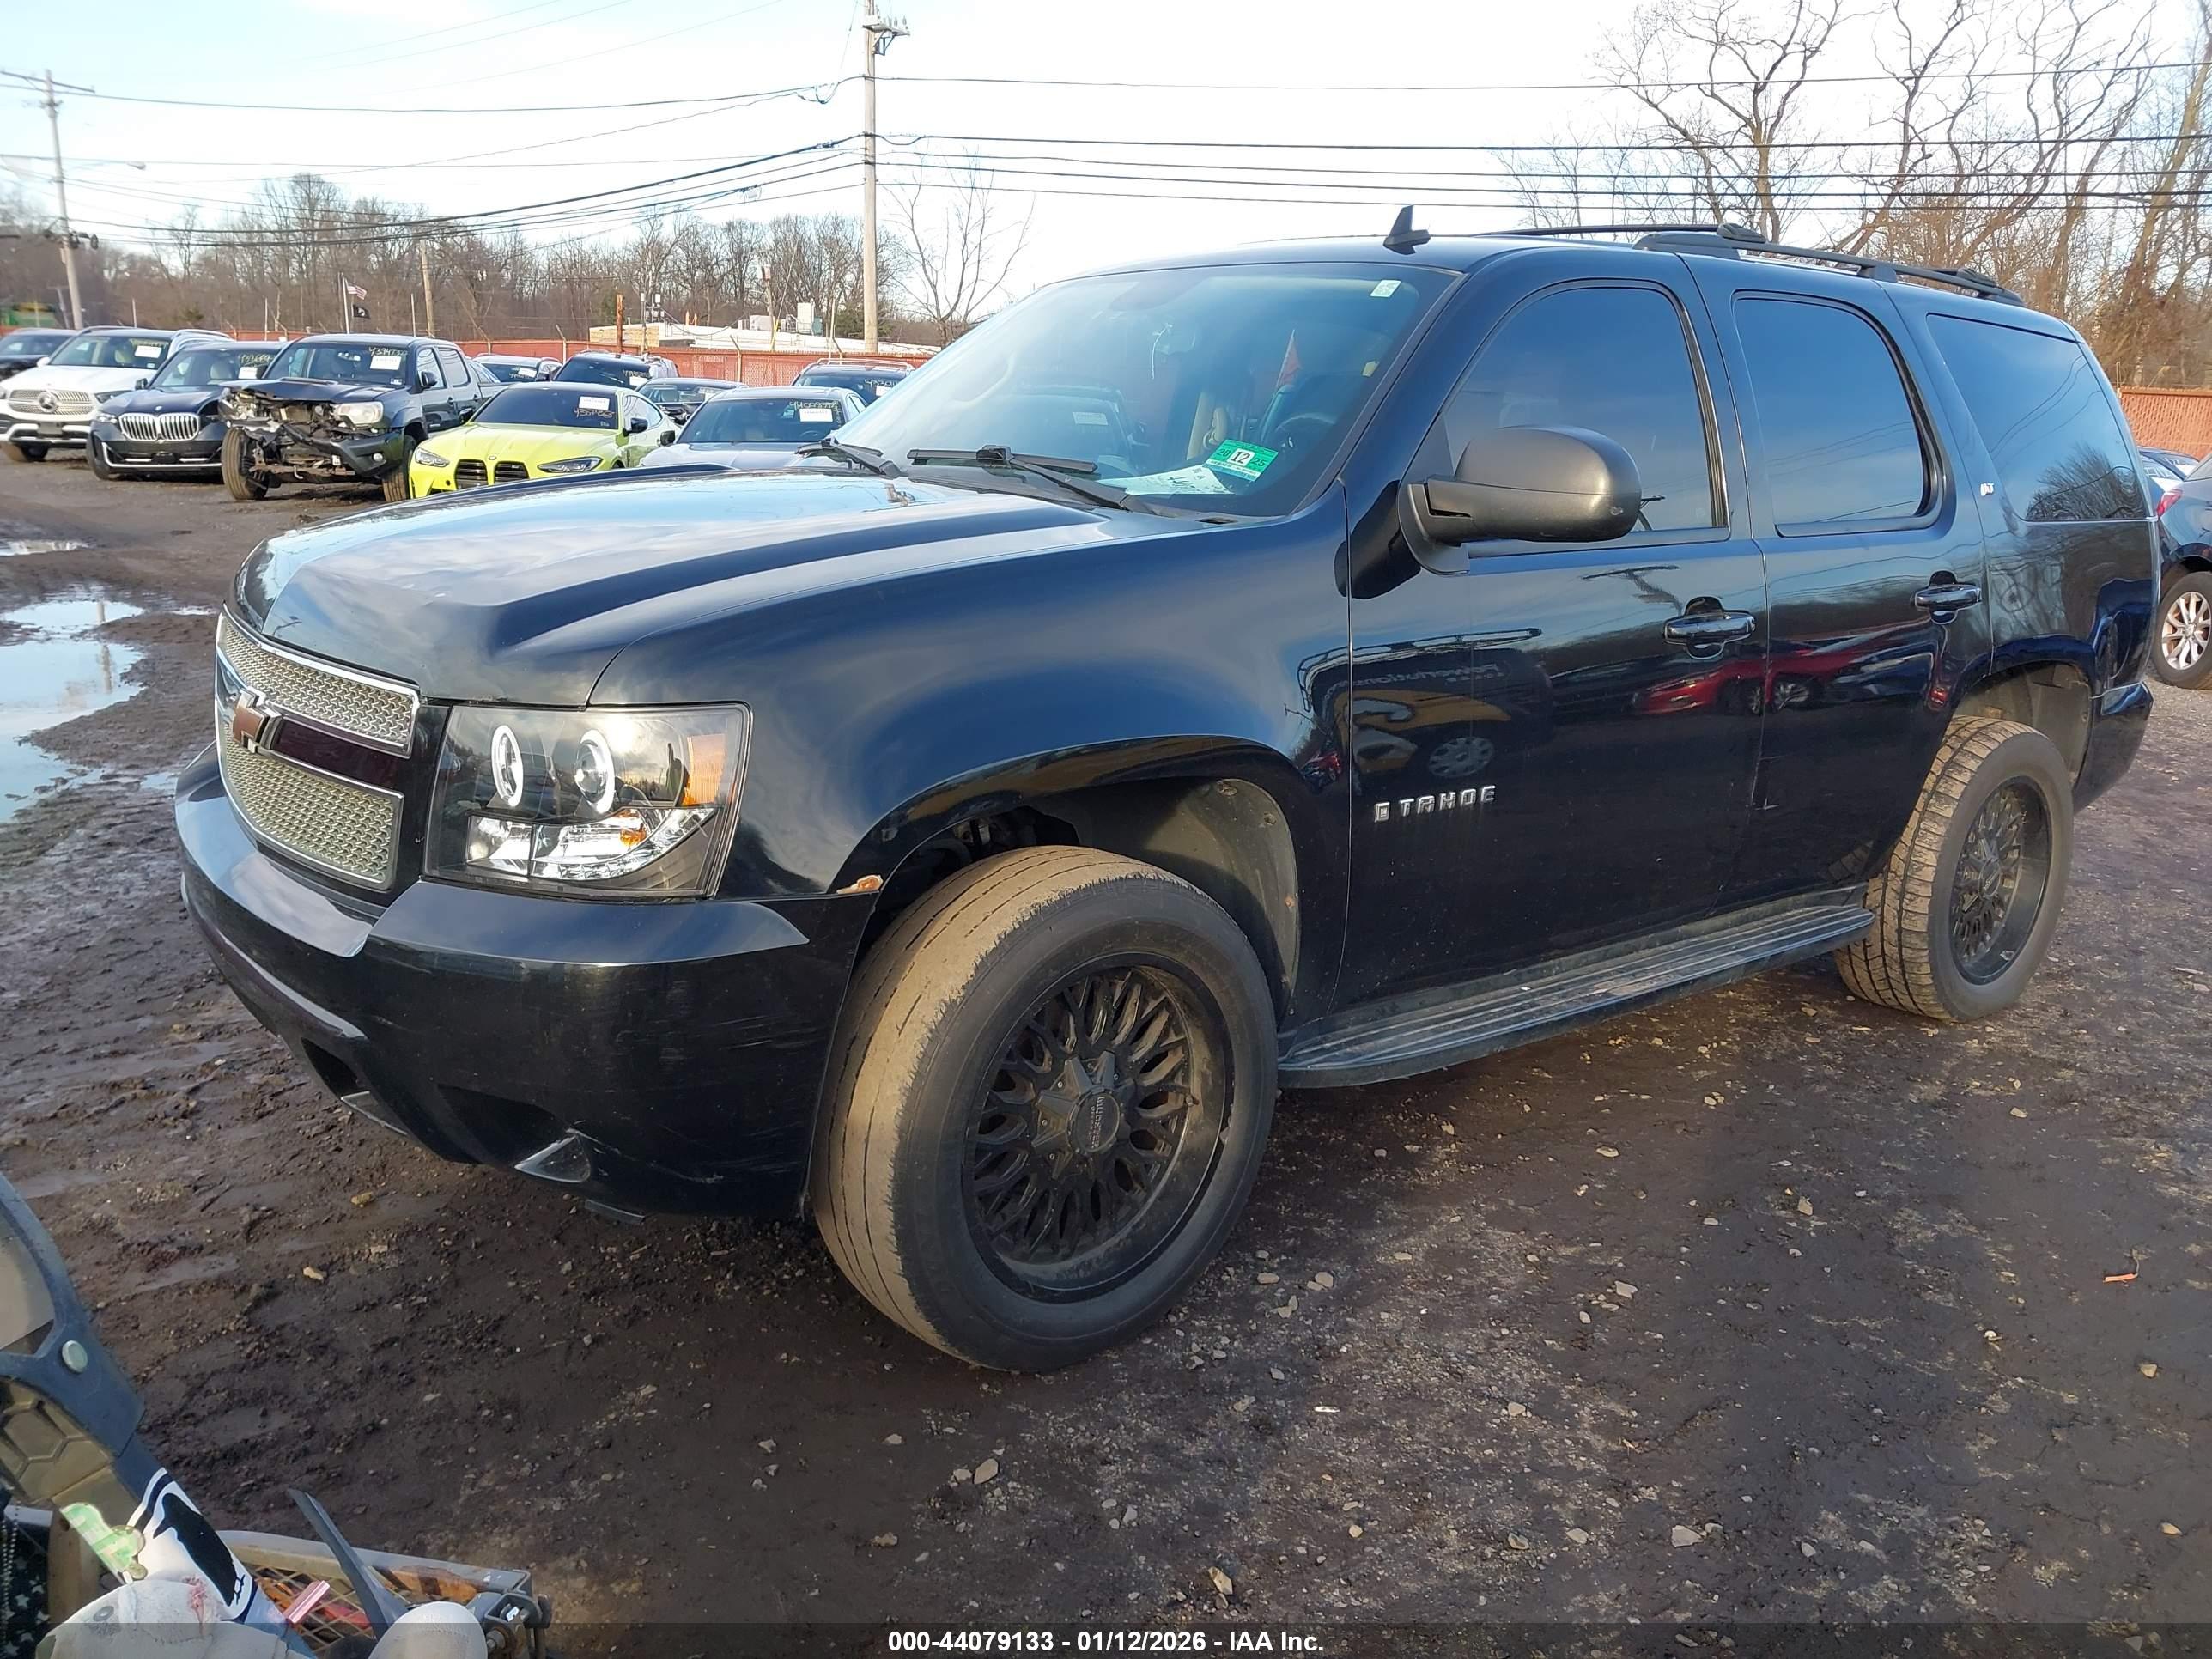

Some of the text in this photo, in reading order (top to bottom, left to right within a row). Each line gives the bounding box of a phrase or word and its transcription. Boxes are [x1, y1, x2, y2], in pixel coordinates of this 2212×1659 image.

[1216, 448, 1231, 457] 20
[1230, 451, 1251, 465] 12
[1251, 458, 1266, 467] 25
[1399, 785, 1496, 817] TAHOE
